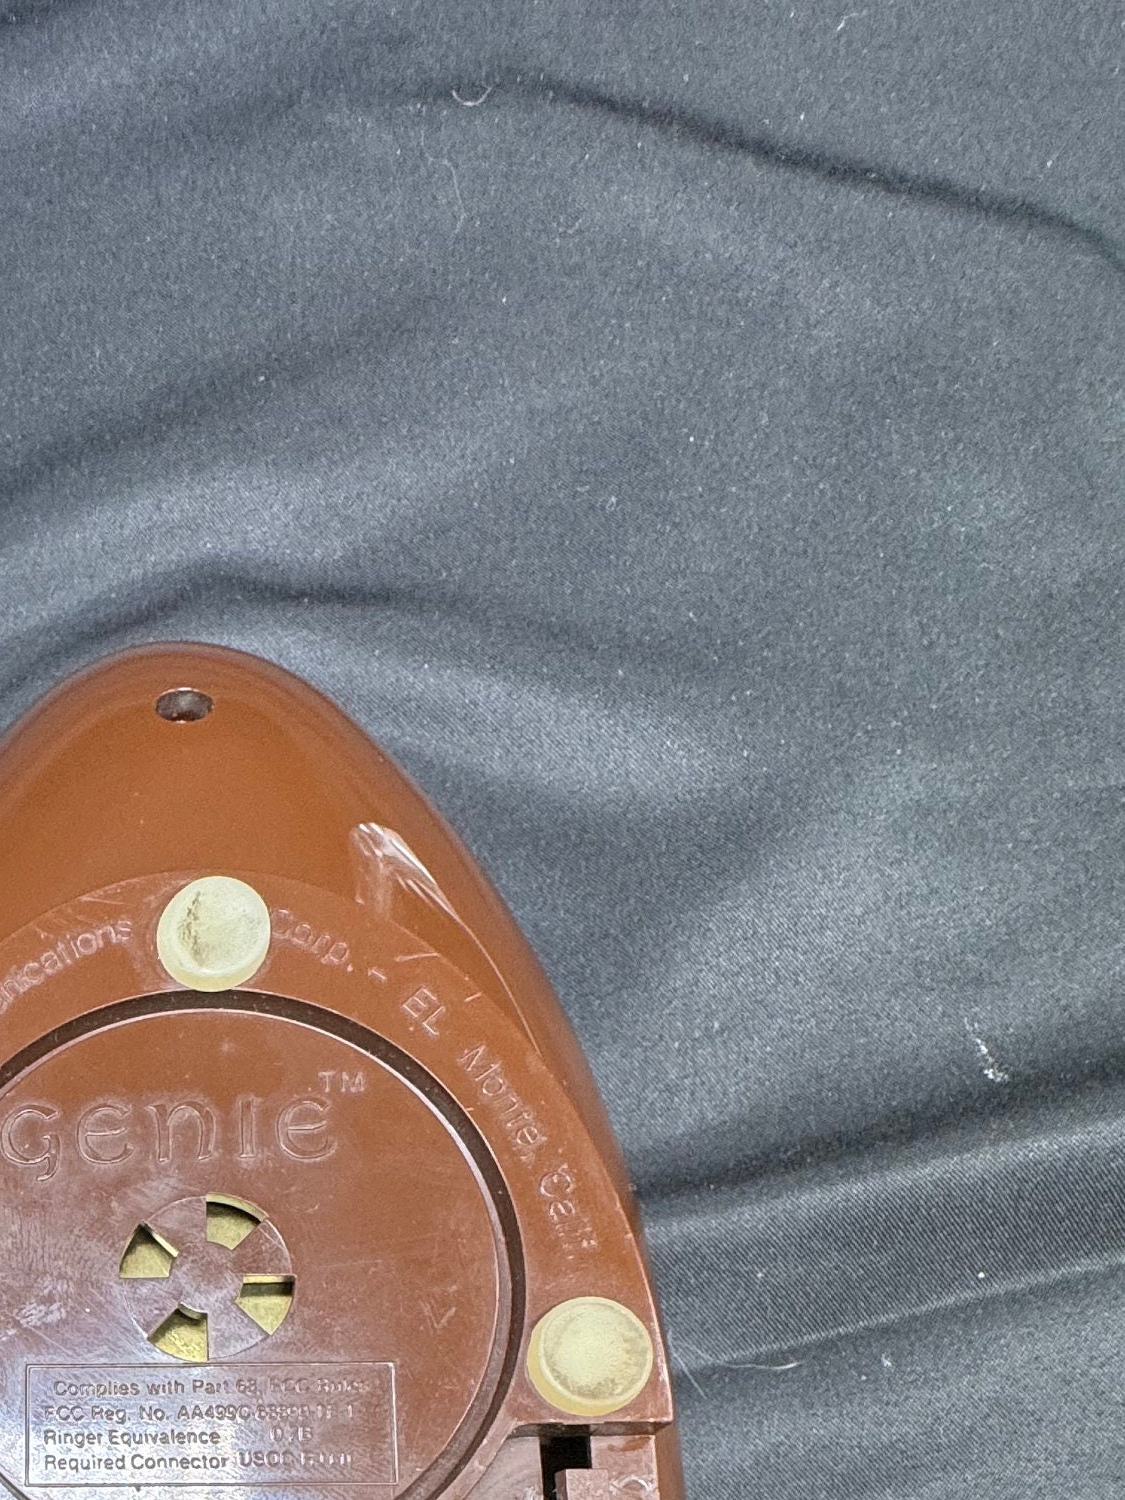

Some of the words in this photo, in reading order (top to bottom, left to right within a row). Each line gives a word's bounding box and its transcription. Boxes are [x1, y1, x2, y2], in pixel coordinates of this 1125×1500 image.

[54, 1381, 140, 1397] Complies
[146, 1379, 185, 1395] with
[192, 1379, 230, 1394] Part
[269, 1377, 310, 1394] FCC
[44, 1404, 85, 1422] FCC
[91, 1405, 132, 1424] Reg.
[139, 1404, 171, 1421] No.
[44, 1429, 103, 1448] Ringer
[108, 1428, 221, 1446] Equivalence
[44, 1453, 126, 1472] Required
[131, 1454, 228, 1470] Connector
[238, 1451, 295, 1468] USOC
